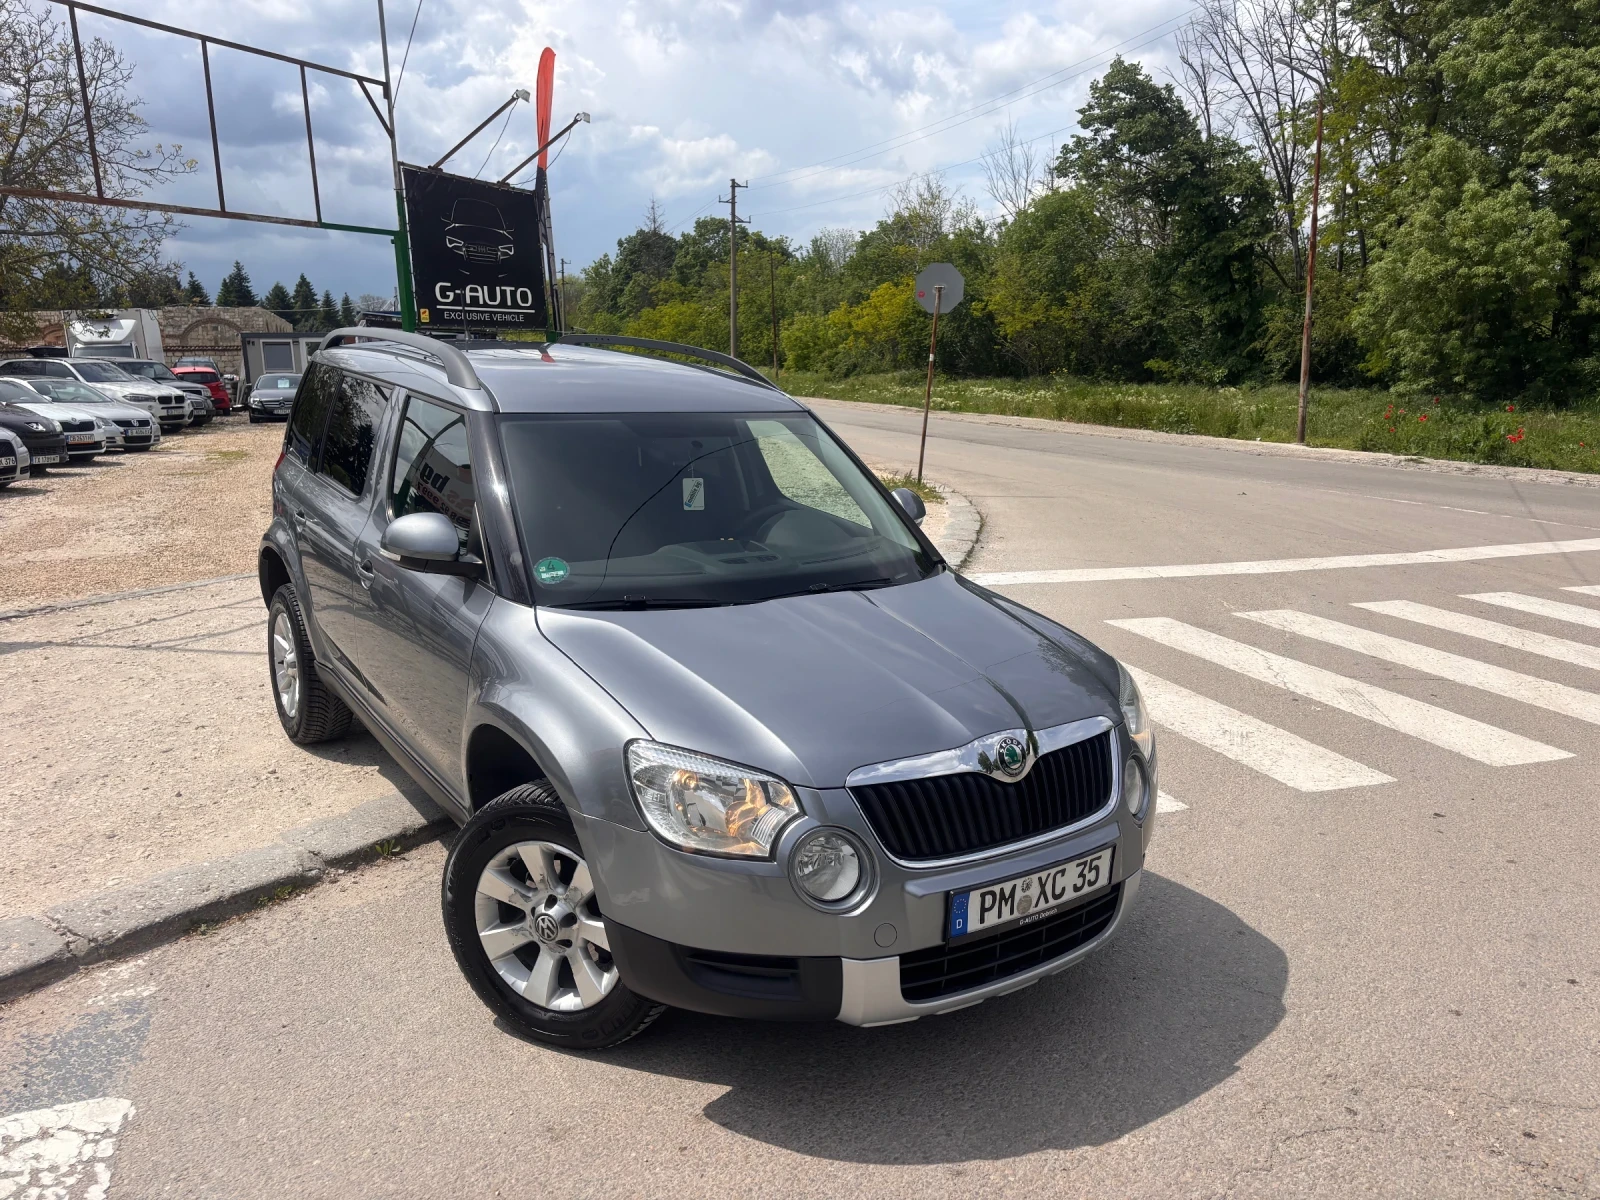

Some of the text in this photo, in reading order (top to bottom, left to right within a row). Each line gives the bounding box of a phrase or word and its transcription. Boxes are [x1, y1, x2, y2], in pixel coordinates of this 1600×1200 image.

[435, 281, 532, 307] G-AUTO
[444, 311, 525, 322] EXCLUSIVE VEHICLE
[547, 560, 556, 571] 4
[979, 855, 1103, 925] PM XC 35
[1019, 913, 1039, 926] G-AUTO
